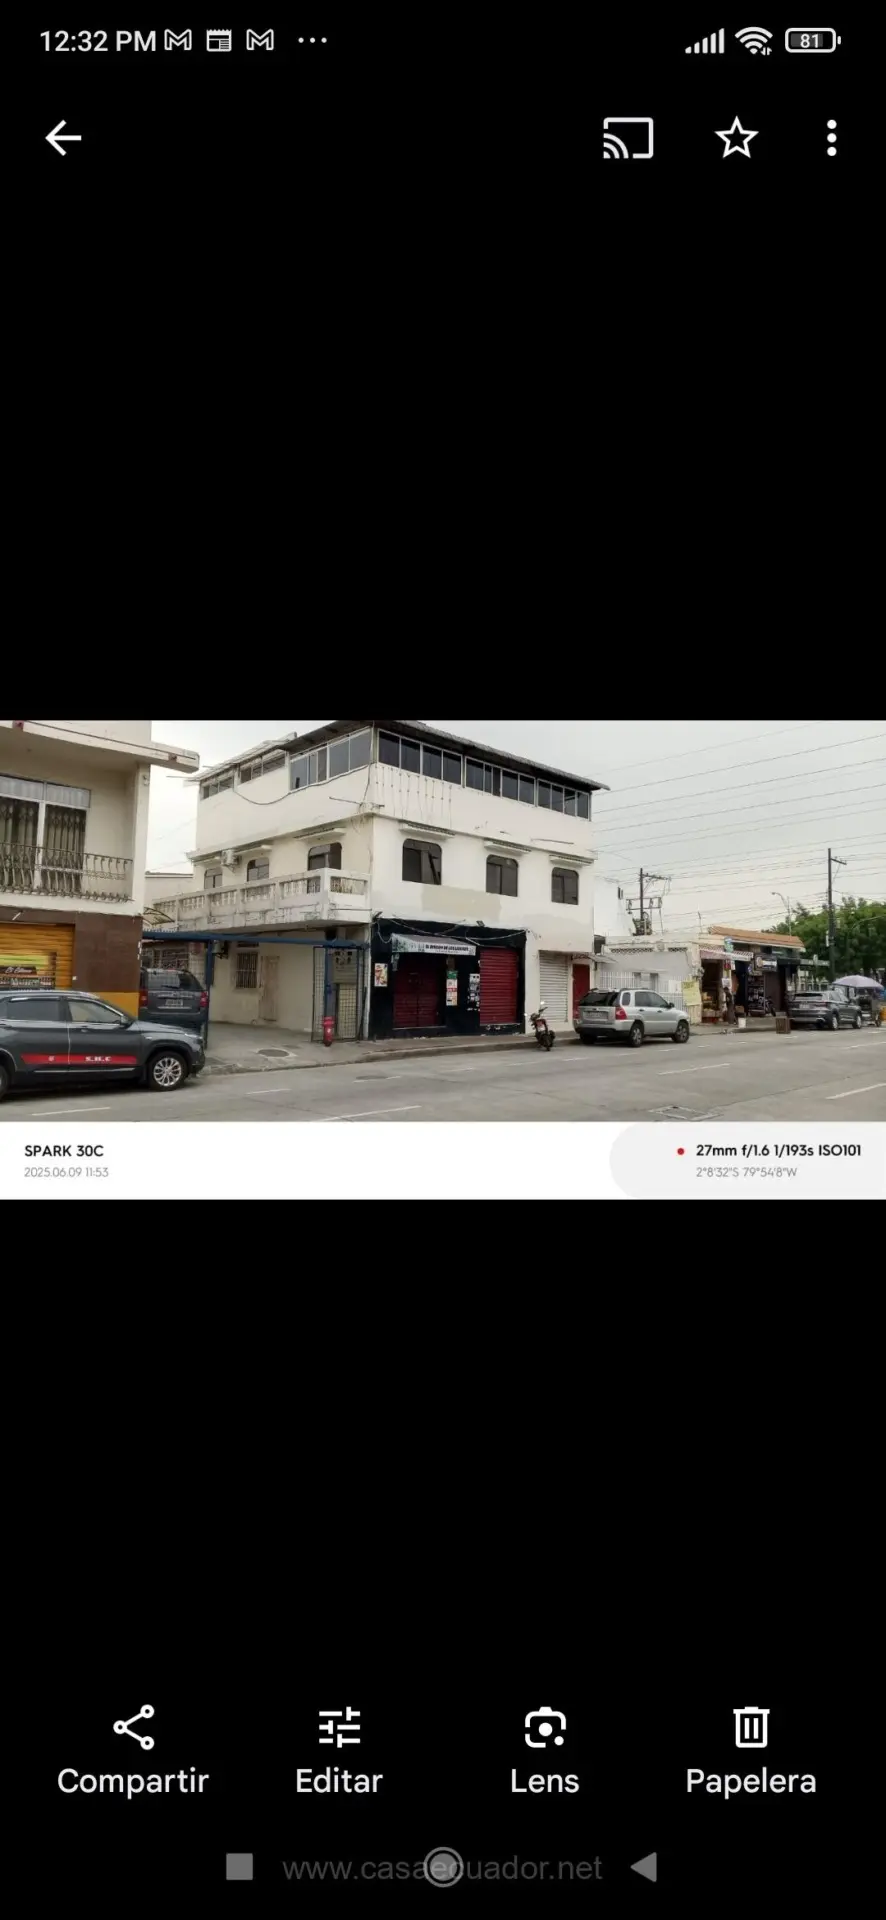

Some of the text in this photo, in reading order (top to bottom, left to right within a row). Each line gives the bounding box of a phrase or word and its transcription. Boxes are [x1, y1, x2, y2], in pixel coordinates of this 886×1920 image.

[40, 30, 157, 52] 12:32 PM
[800, 33, 819, 49] 81
[57, 1766, 210, 1800] Compartir
[296, 1766, 384, 1794] Editar
[511, 1767, 580, 1794] Lens
[686, 1766, 817, 1800] Papelera
